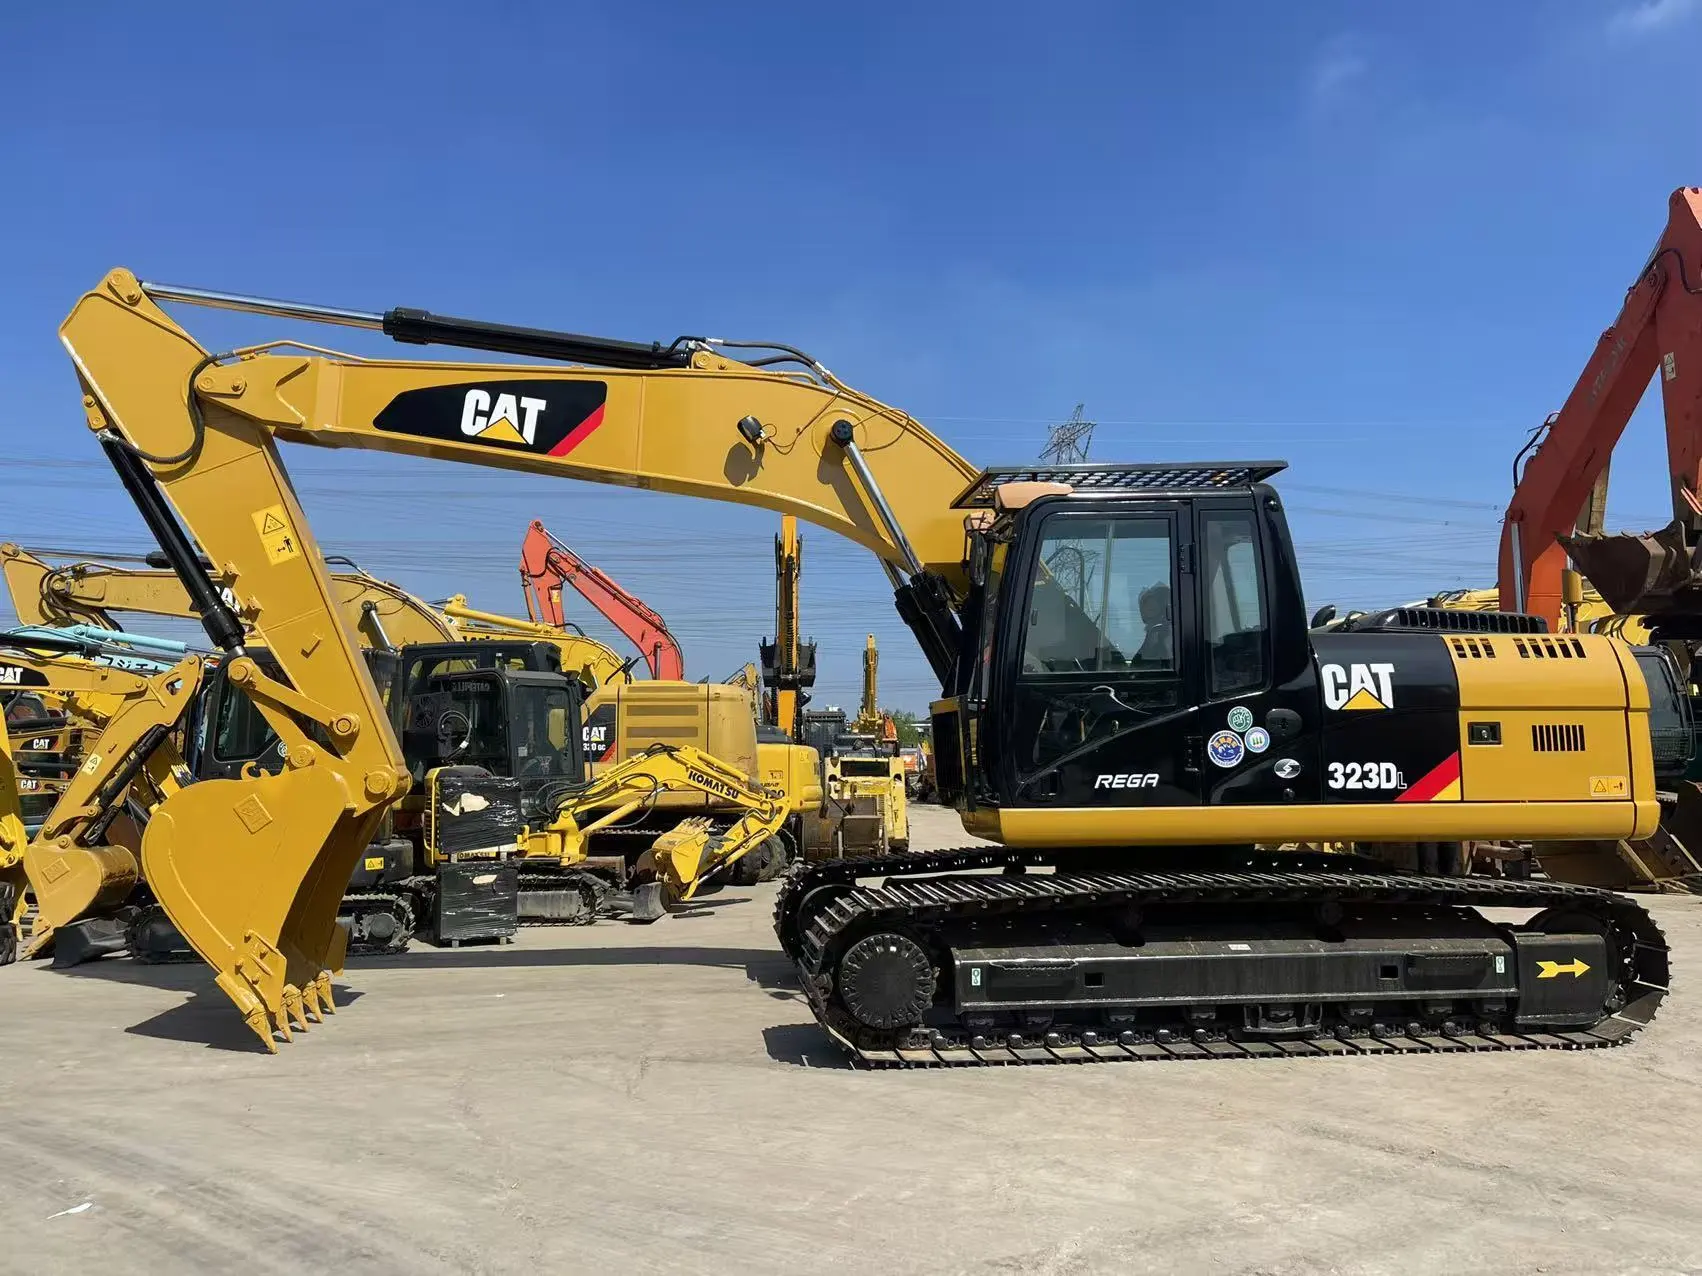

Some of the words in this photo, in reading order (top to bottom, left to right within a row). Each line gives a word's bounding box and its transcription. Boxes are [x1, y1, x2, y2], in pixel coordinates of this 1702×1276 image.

[461, 389, 547, 445] CAT
[1321, 663, 1395, 710] CAT
[582, 726, 607, 741] CAT
[32, 738, 50, 750] CAT
[21, 779, 37, 789] CAT
[688, 770, 739, 799] KOMATSU
[1094, 773, 1160, 789] REGA
